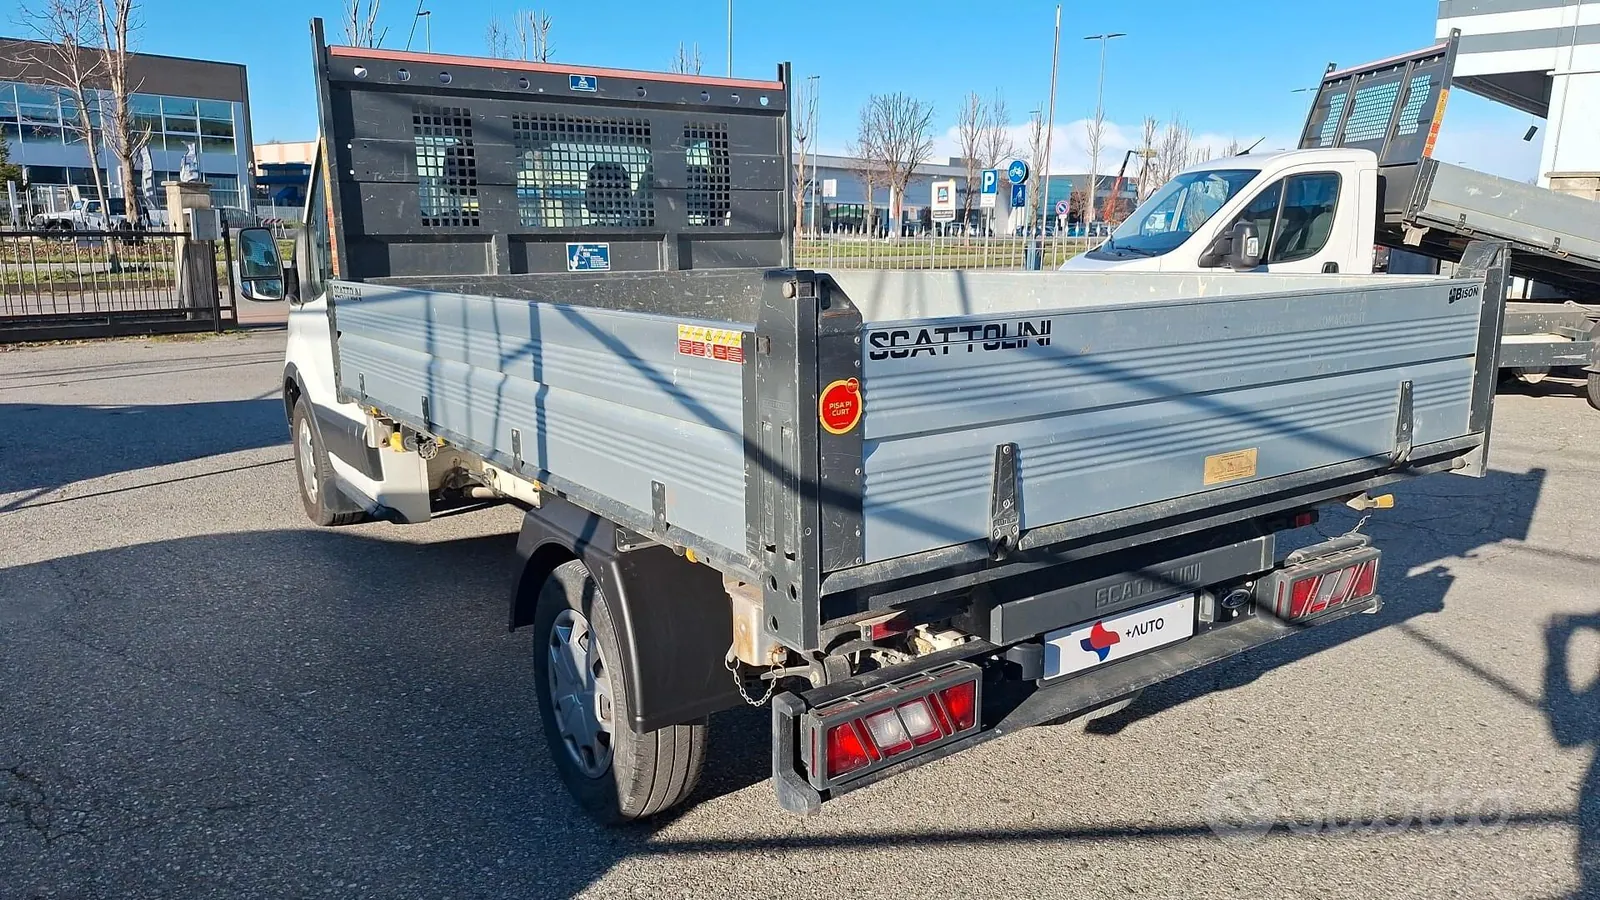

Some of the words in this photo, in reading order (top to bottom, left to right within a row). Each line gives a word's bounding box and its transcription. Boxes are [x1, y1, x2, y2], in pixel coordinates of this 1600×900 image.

[983, 171, 996, 193] P
[1455, 285, 1480, 301] BISON
[869, 320, 1052, 361] SCATTOLINI
[831, 408, 850, 417] CURT
